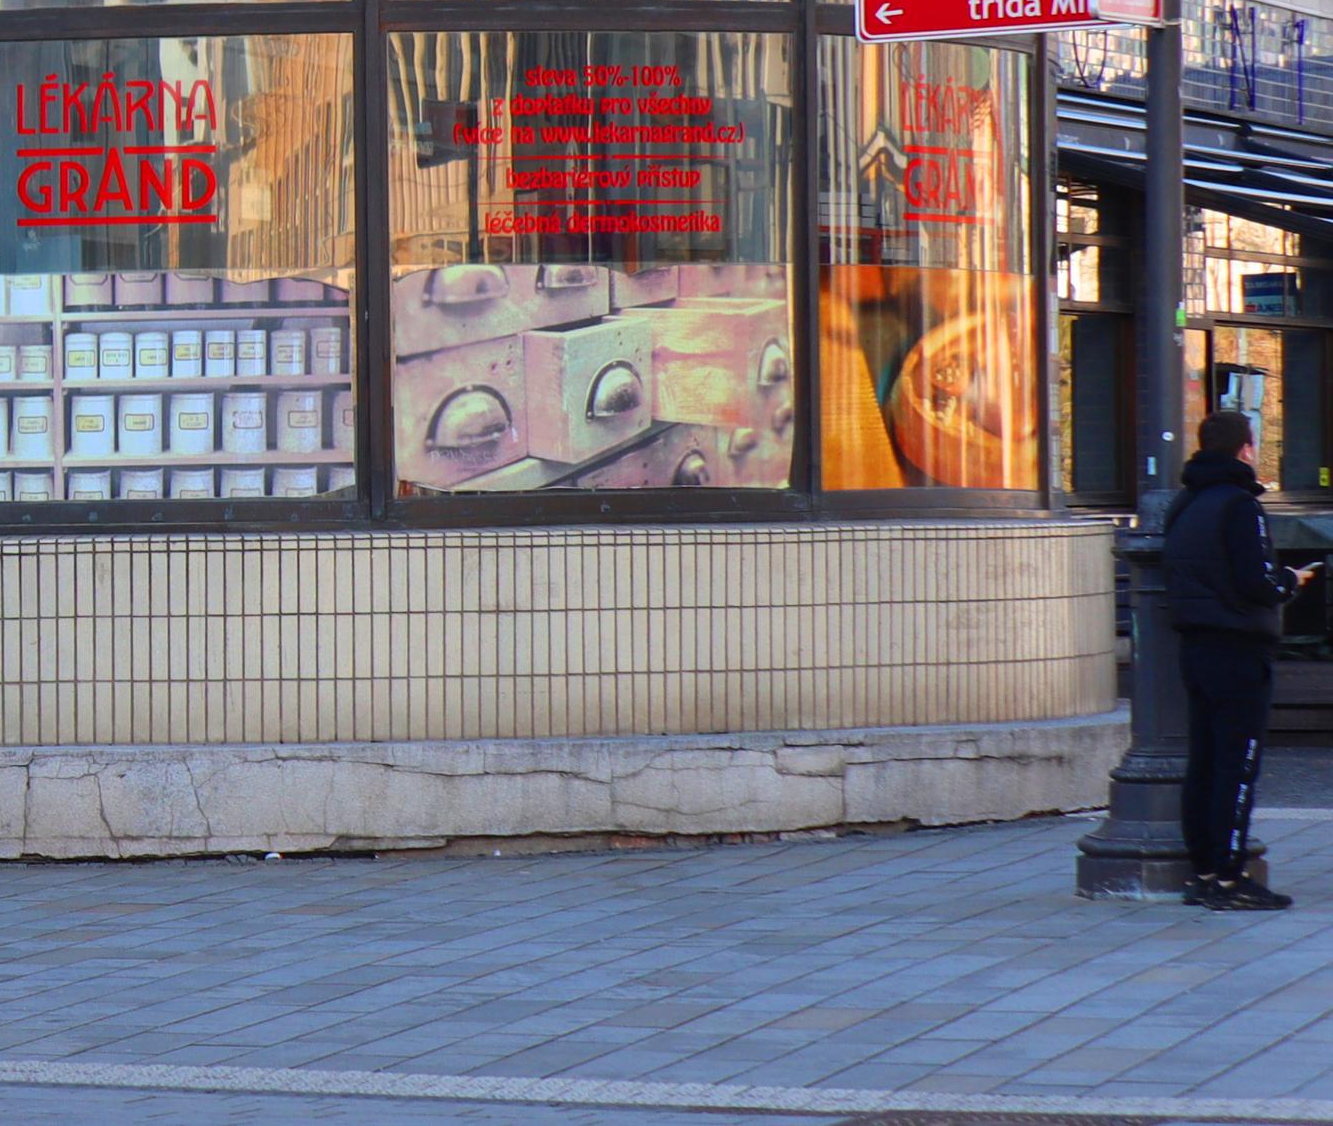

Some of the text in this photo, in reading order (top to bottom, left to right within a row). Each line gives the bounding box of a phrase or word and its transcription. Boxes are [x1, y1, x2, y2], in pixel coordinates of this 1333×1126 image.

[16, 71, 217, 135] LÉKÁRNA
[525, 66, 578, 87] sleva
[901, 74, 1002, 138] LÉKÁR
[16, 146, 217, 214] GRAND
[903, 150, 997, 211] GRAN
